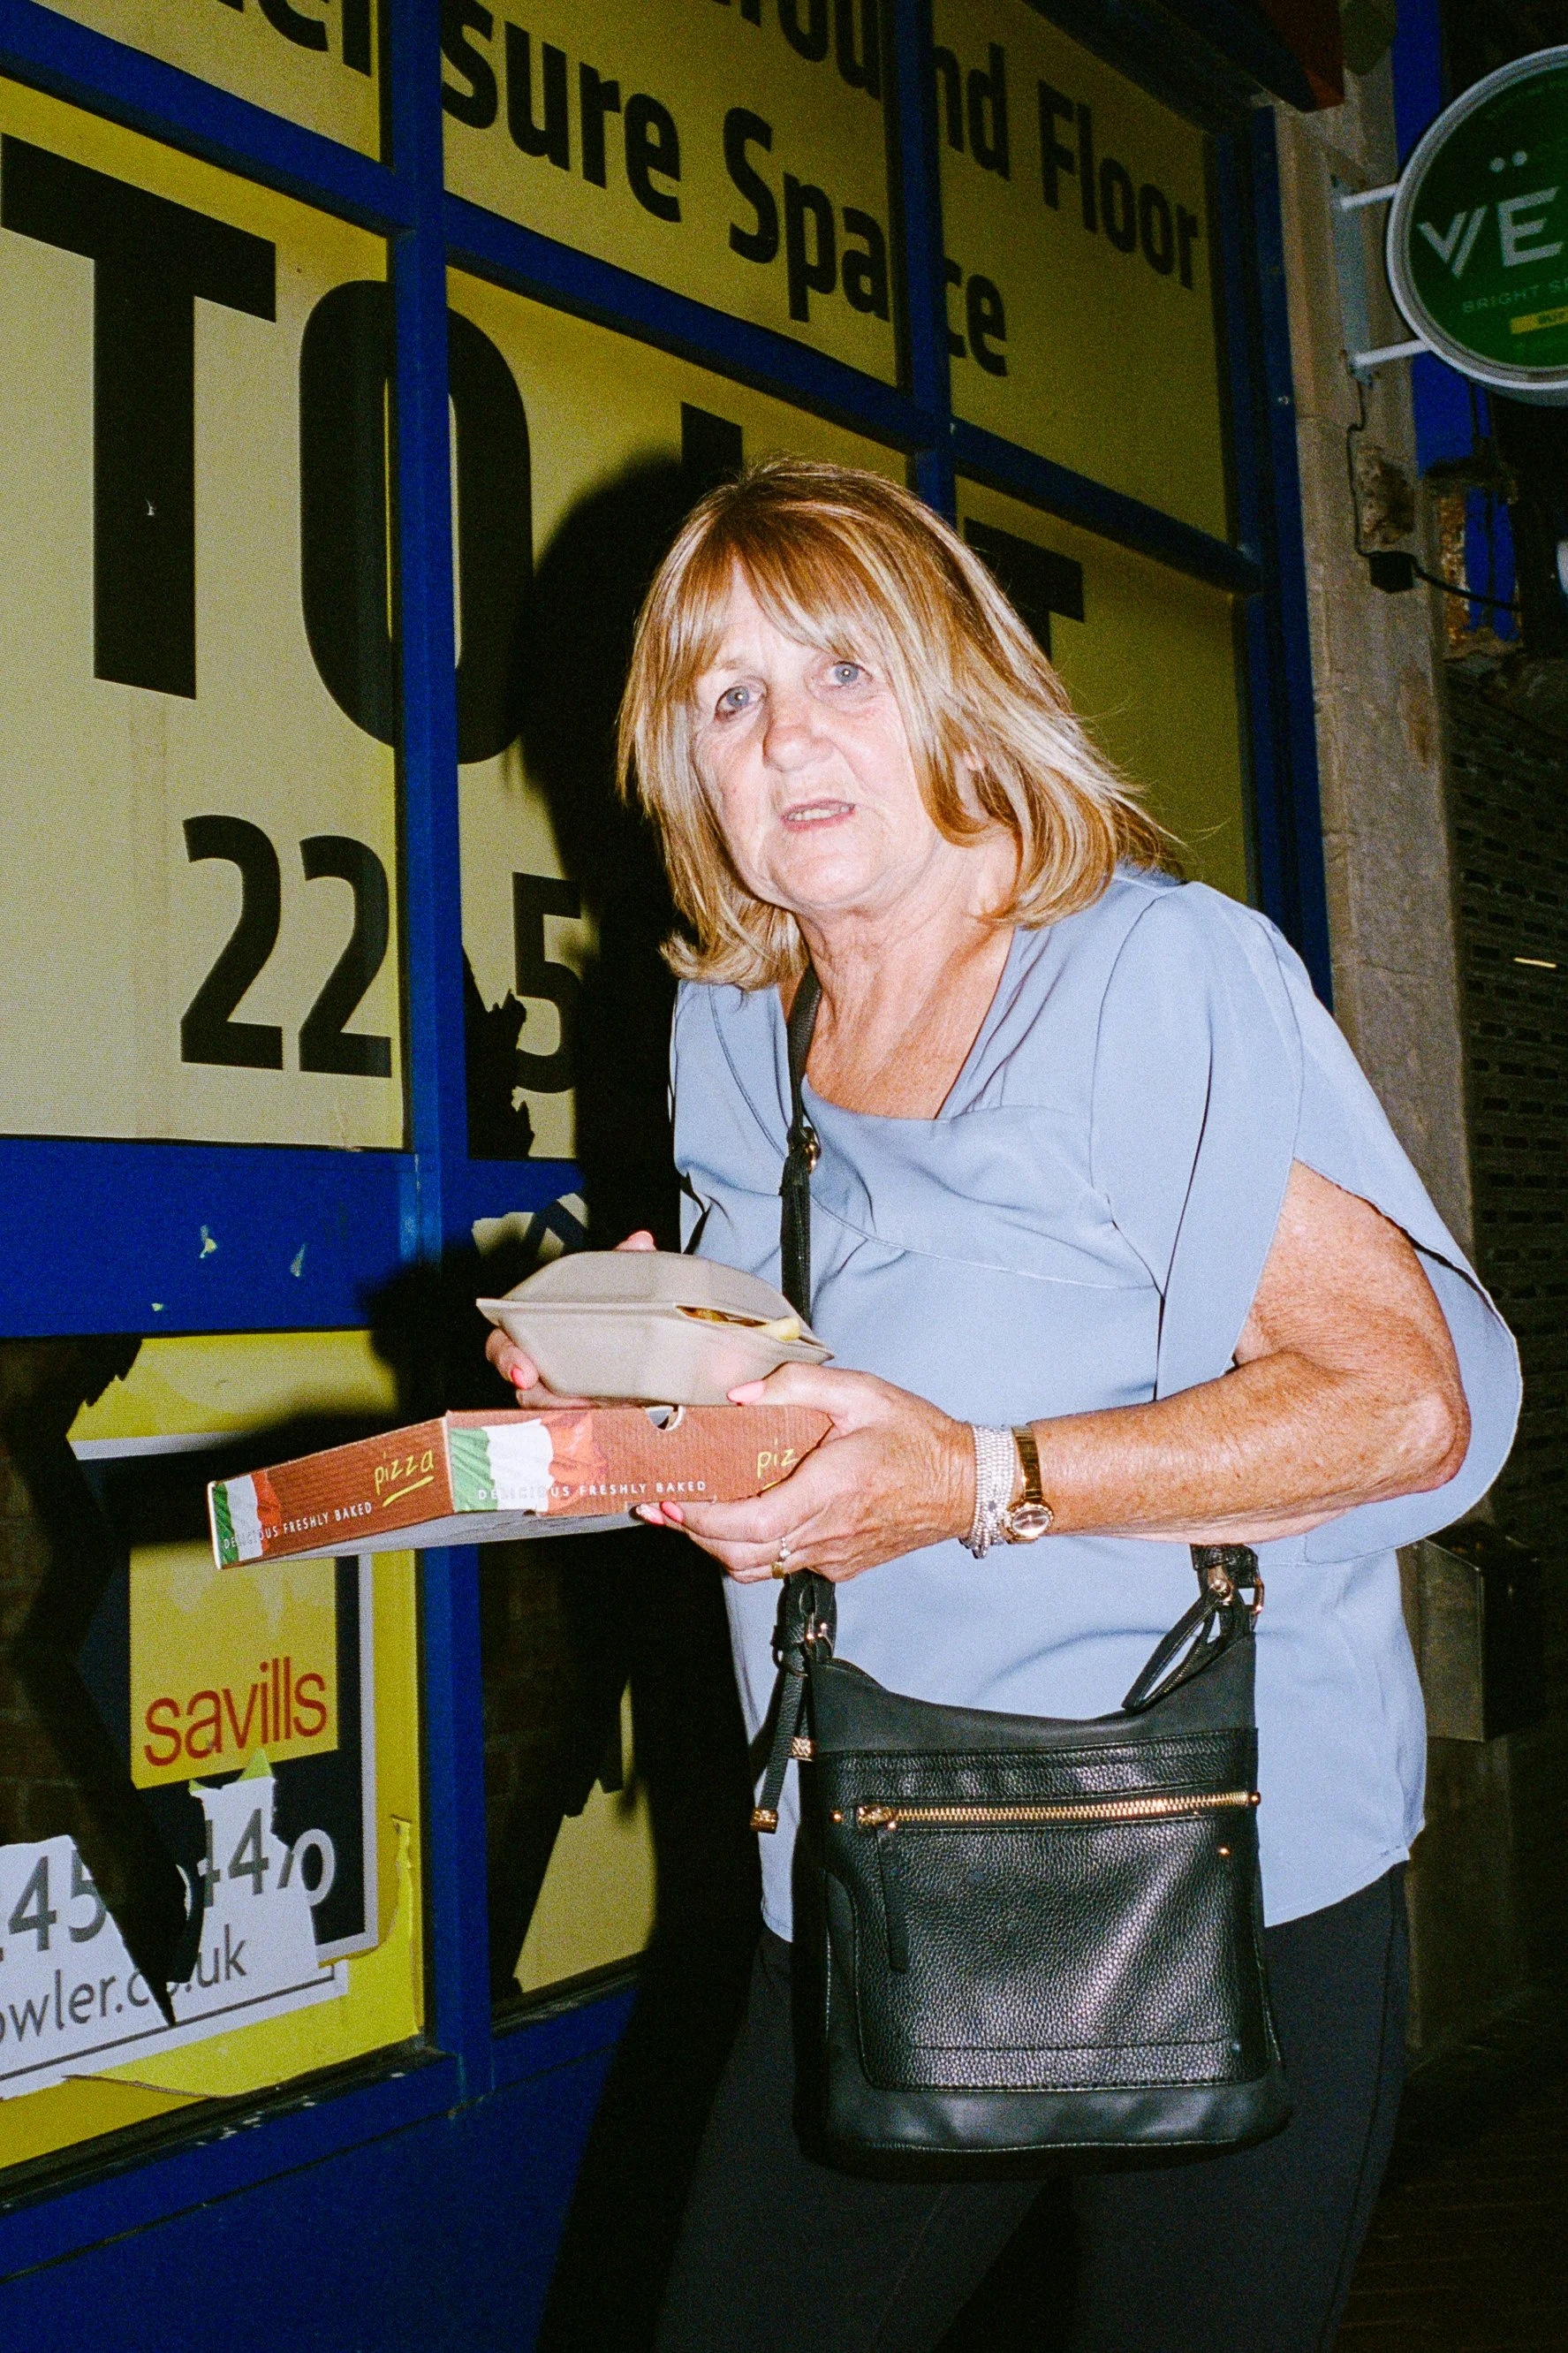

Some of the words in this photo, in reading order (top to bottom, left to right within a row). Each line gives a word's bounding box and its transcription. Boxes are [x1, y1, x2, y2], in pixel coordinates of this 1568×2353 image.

[1039, 80, 1198, 290] Floor
[1461, 285, 1540, 315] BRIGHT
[0, 132, 533, 763] TO
[374, 1449, 435, 1496] pizza
[756, 1438, 801, 1480] piz
[579, 1483, 648, 1497] FRESHLY
[655, 1480, 707, 1494] BAKED
[283, 1512, 330, 1535] FRESHLY
[334, 1501, 372, 1522] BAKED
[144, 1656, 327, 1766] savills
